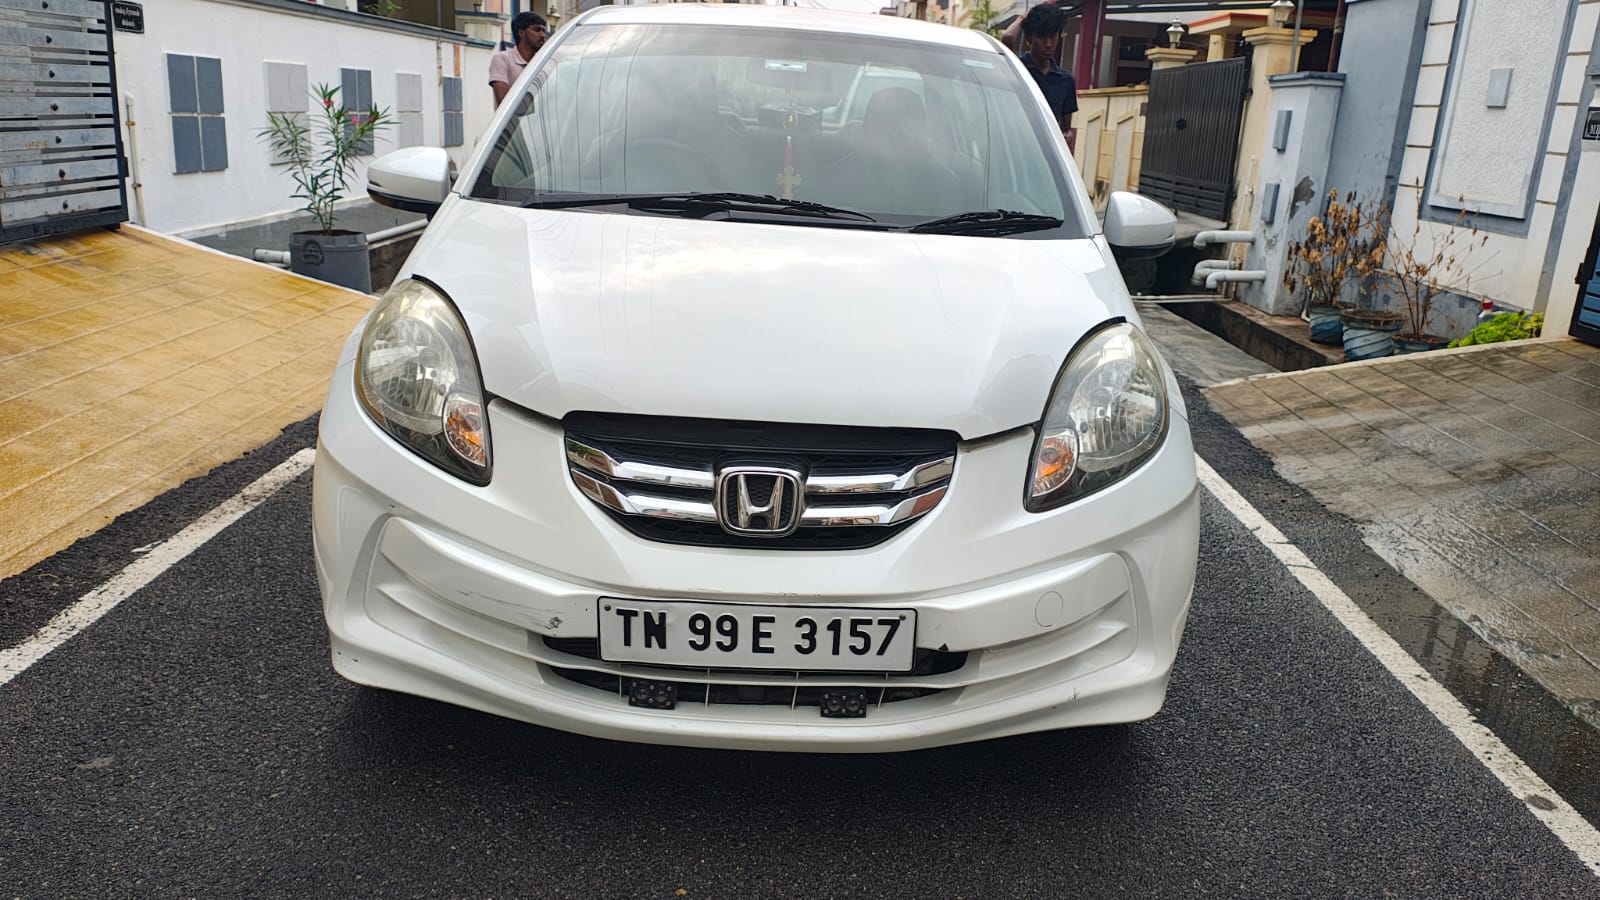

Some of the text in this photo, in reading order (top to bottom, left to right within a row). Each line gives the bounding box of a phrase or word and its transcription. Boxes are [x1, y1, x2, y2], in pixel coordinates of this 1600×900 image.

[616, 608, 901, 656] TN 99 E 3157
